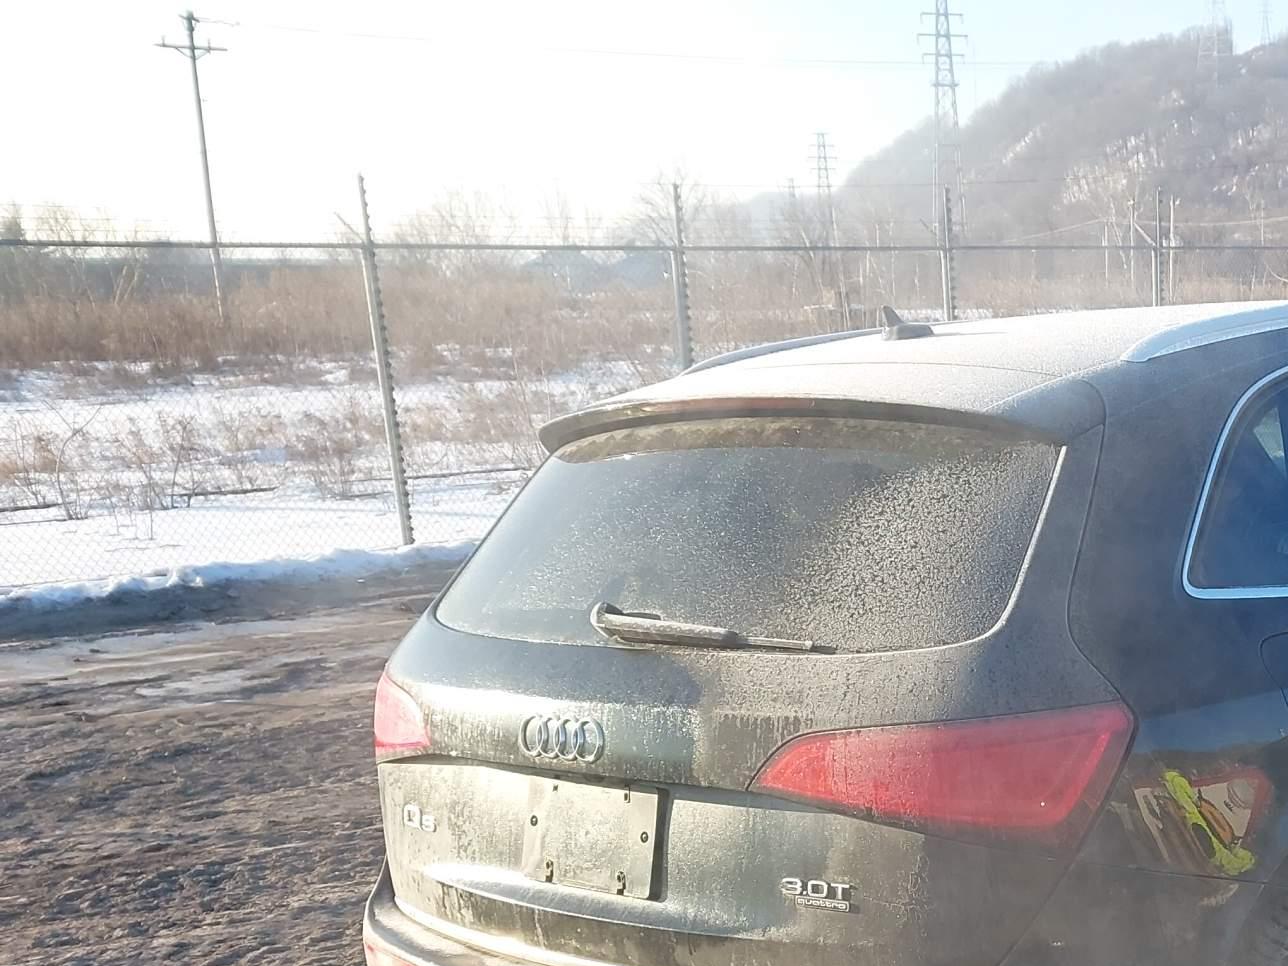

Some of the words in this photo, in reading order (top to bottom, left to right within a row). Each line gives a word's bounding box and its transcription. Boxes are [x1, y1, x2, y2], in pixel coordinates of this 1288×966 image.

[403, 804, 436, 832] Q5
[781, 878, 850, 900] 3.0T
[797, 898, 847, 910] quattro
